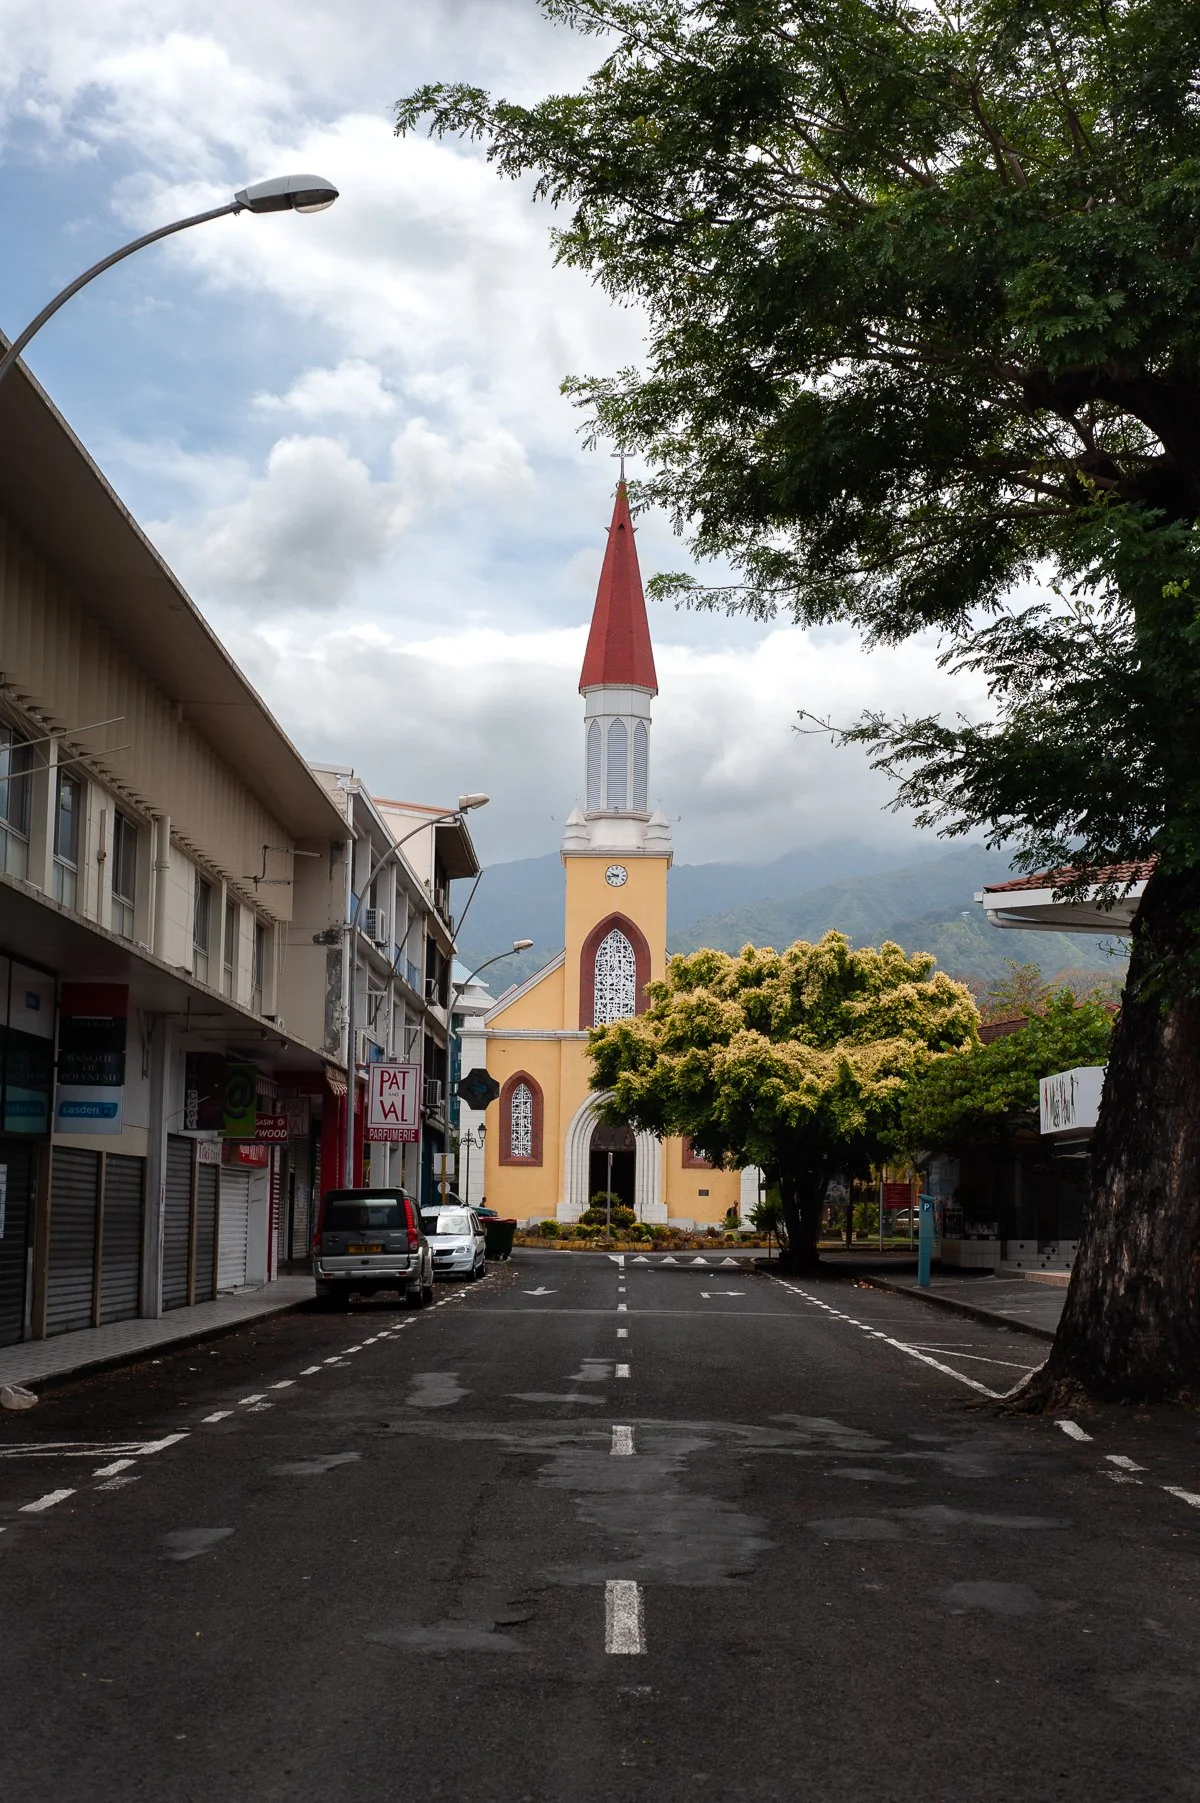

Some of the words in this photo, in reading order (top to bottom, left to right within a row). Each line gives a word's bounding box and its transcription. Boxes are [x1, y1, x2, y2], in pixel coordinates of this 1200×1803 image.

[67, 1054, 112, 1063] BANQUE
[380, 1069, 410, 1098] PAT
[63, 1104, 99, 1115] casden
[379, 1094, 408, 1122] VAL
[369, 1129, 415, 1141] PARFUMERIE
[924, 1203, 930, 1211] P
